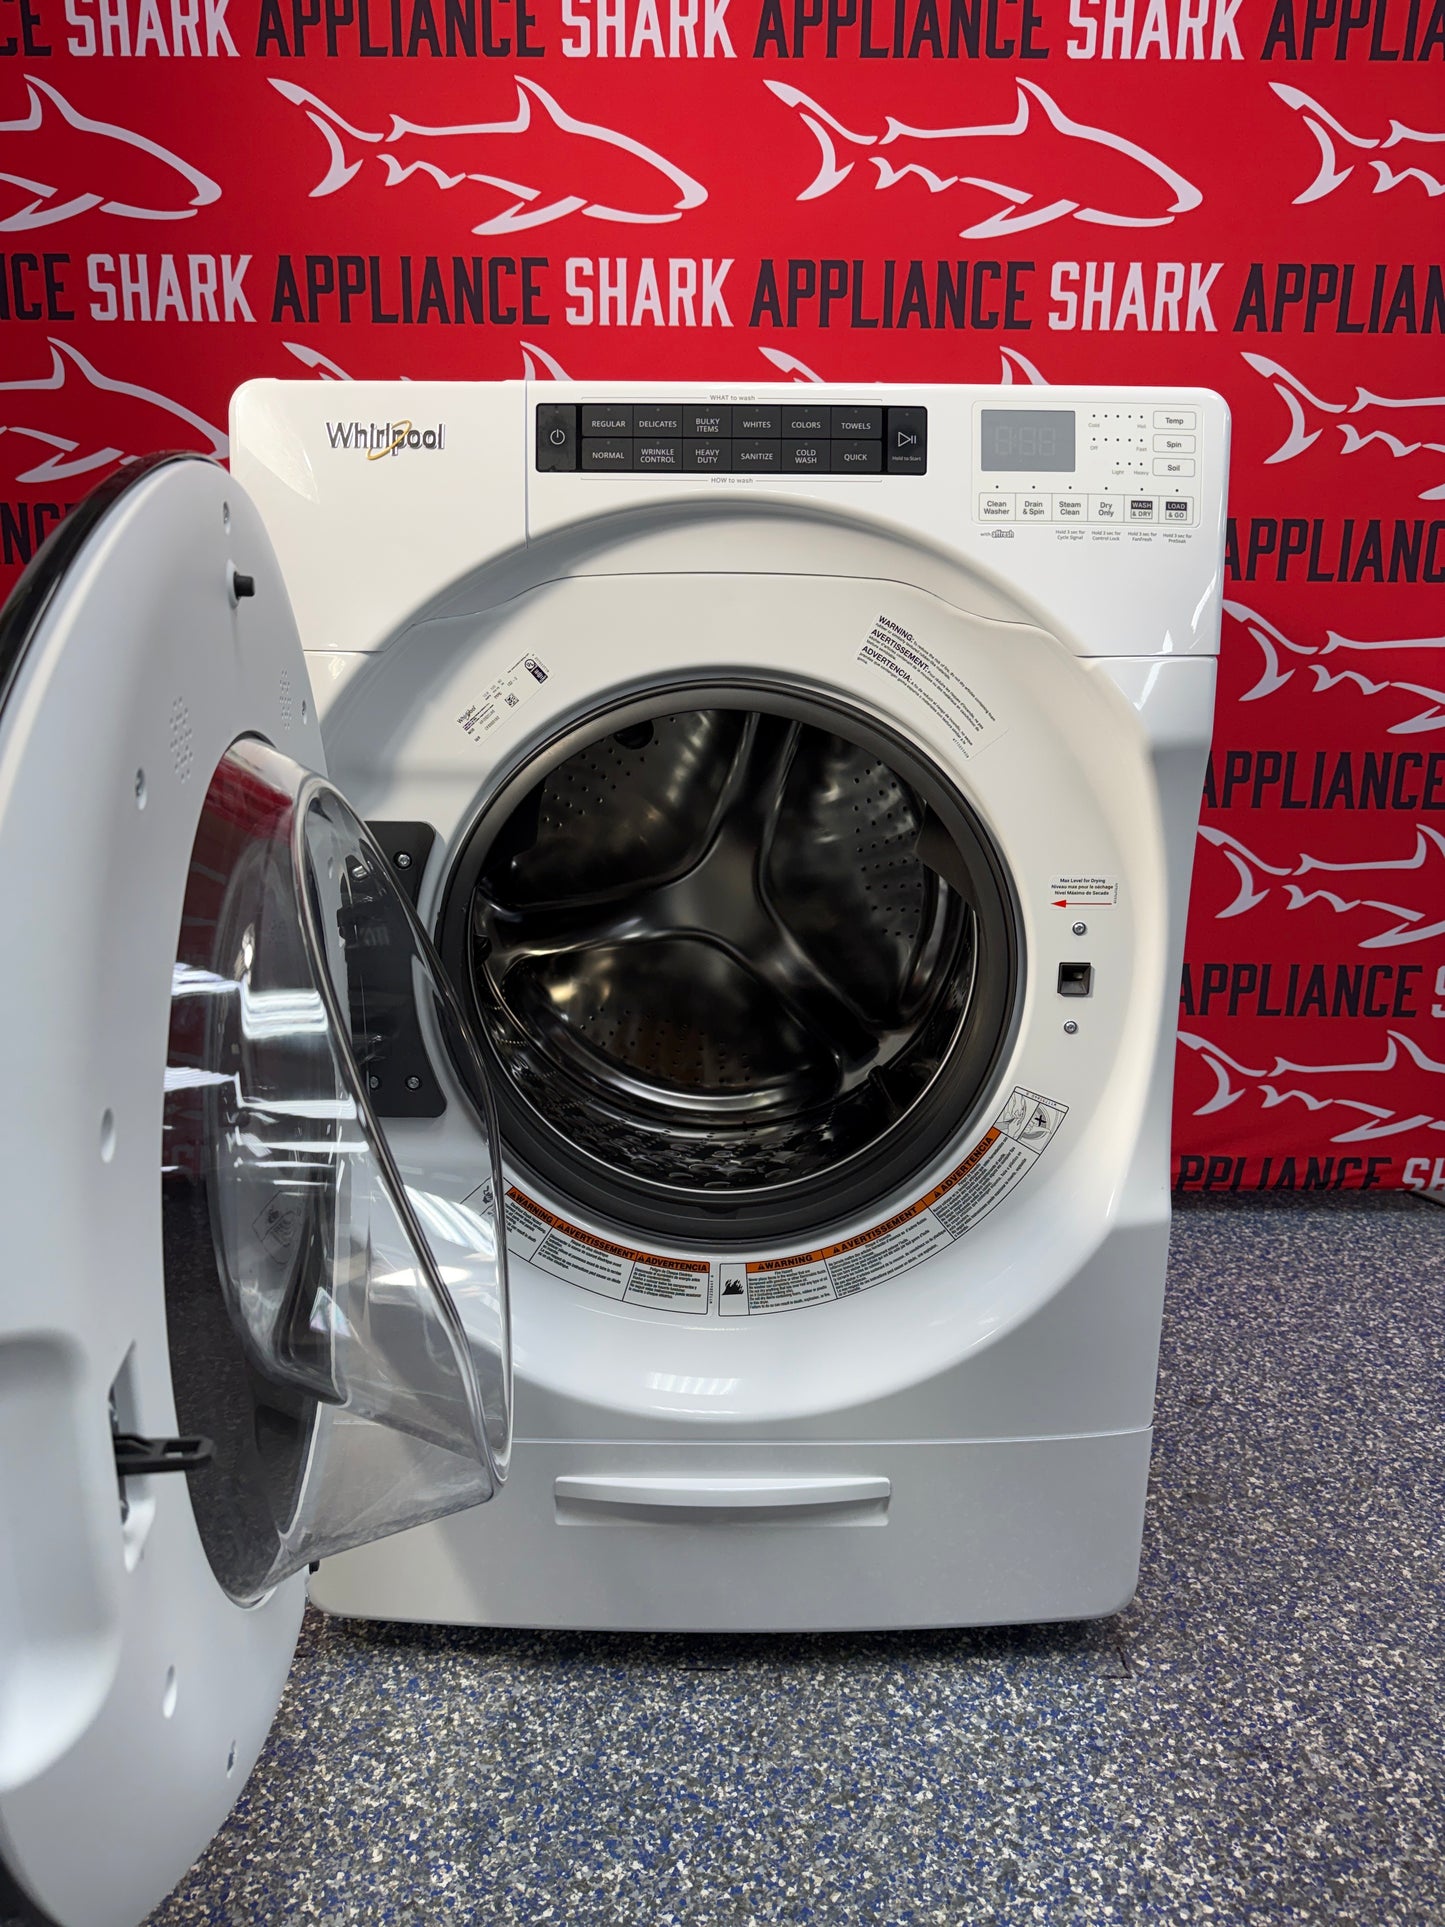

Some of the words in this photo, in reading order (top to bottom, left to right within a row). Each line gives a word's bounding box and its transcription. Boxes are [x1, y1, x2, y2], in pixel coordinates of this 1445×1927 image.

[67, 0, 240, 57] SHARK
[256, 0, 545, 57] APPLIANCE
[561, 0, 737, 58] SHARK
[754, 0, 1049, 59] APPLIANCE
[1067, 0, 1245, 60] SHARK
[87, 253, 257, 322] SHARK
[271, 255, 550, 325] APPLIANCE
[565, 257, 734, 327] SHARK
[749, 259, 1035, 329] APPLIANCE
[1048, 261, 1224, 332] SHARK
[697, 425, 719, 433] ITEMS
[743, 421, 771, 429] WHITES
[791, 421, 821, 429] COLORS
[841, 422, 871, 430] TOWELS
[325, 421, 446, 456] Whirlpool
[1167, 441, 1182, 449] Spin
[844, 454, 867, 462] QUICK
[1029, 508, 1044, 516] Spin
[1098, 509, 1114, 517] Only
[1100, 502, 1112, 510] Dry
[878, 615, 915, 642] WARNING:
[870, 628, 929, 672] AVERTISSEMENT:
[861, 644, 913, 684] ADVERTENCIA:
[939, 1135, 993, 1192] ADVERTENCIA
[513, 1193, 553, 1224] WARNING
[840, 1205, 918, 1252] AVERTISSEMENT
[561, 1224, 634, 1260] AVERTISSEMENT
[644, 1256, 706, 1271] ADVERTENCIA
[764, 1253, 813, 1269] WARNING
